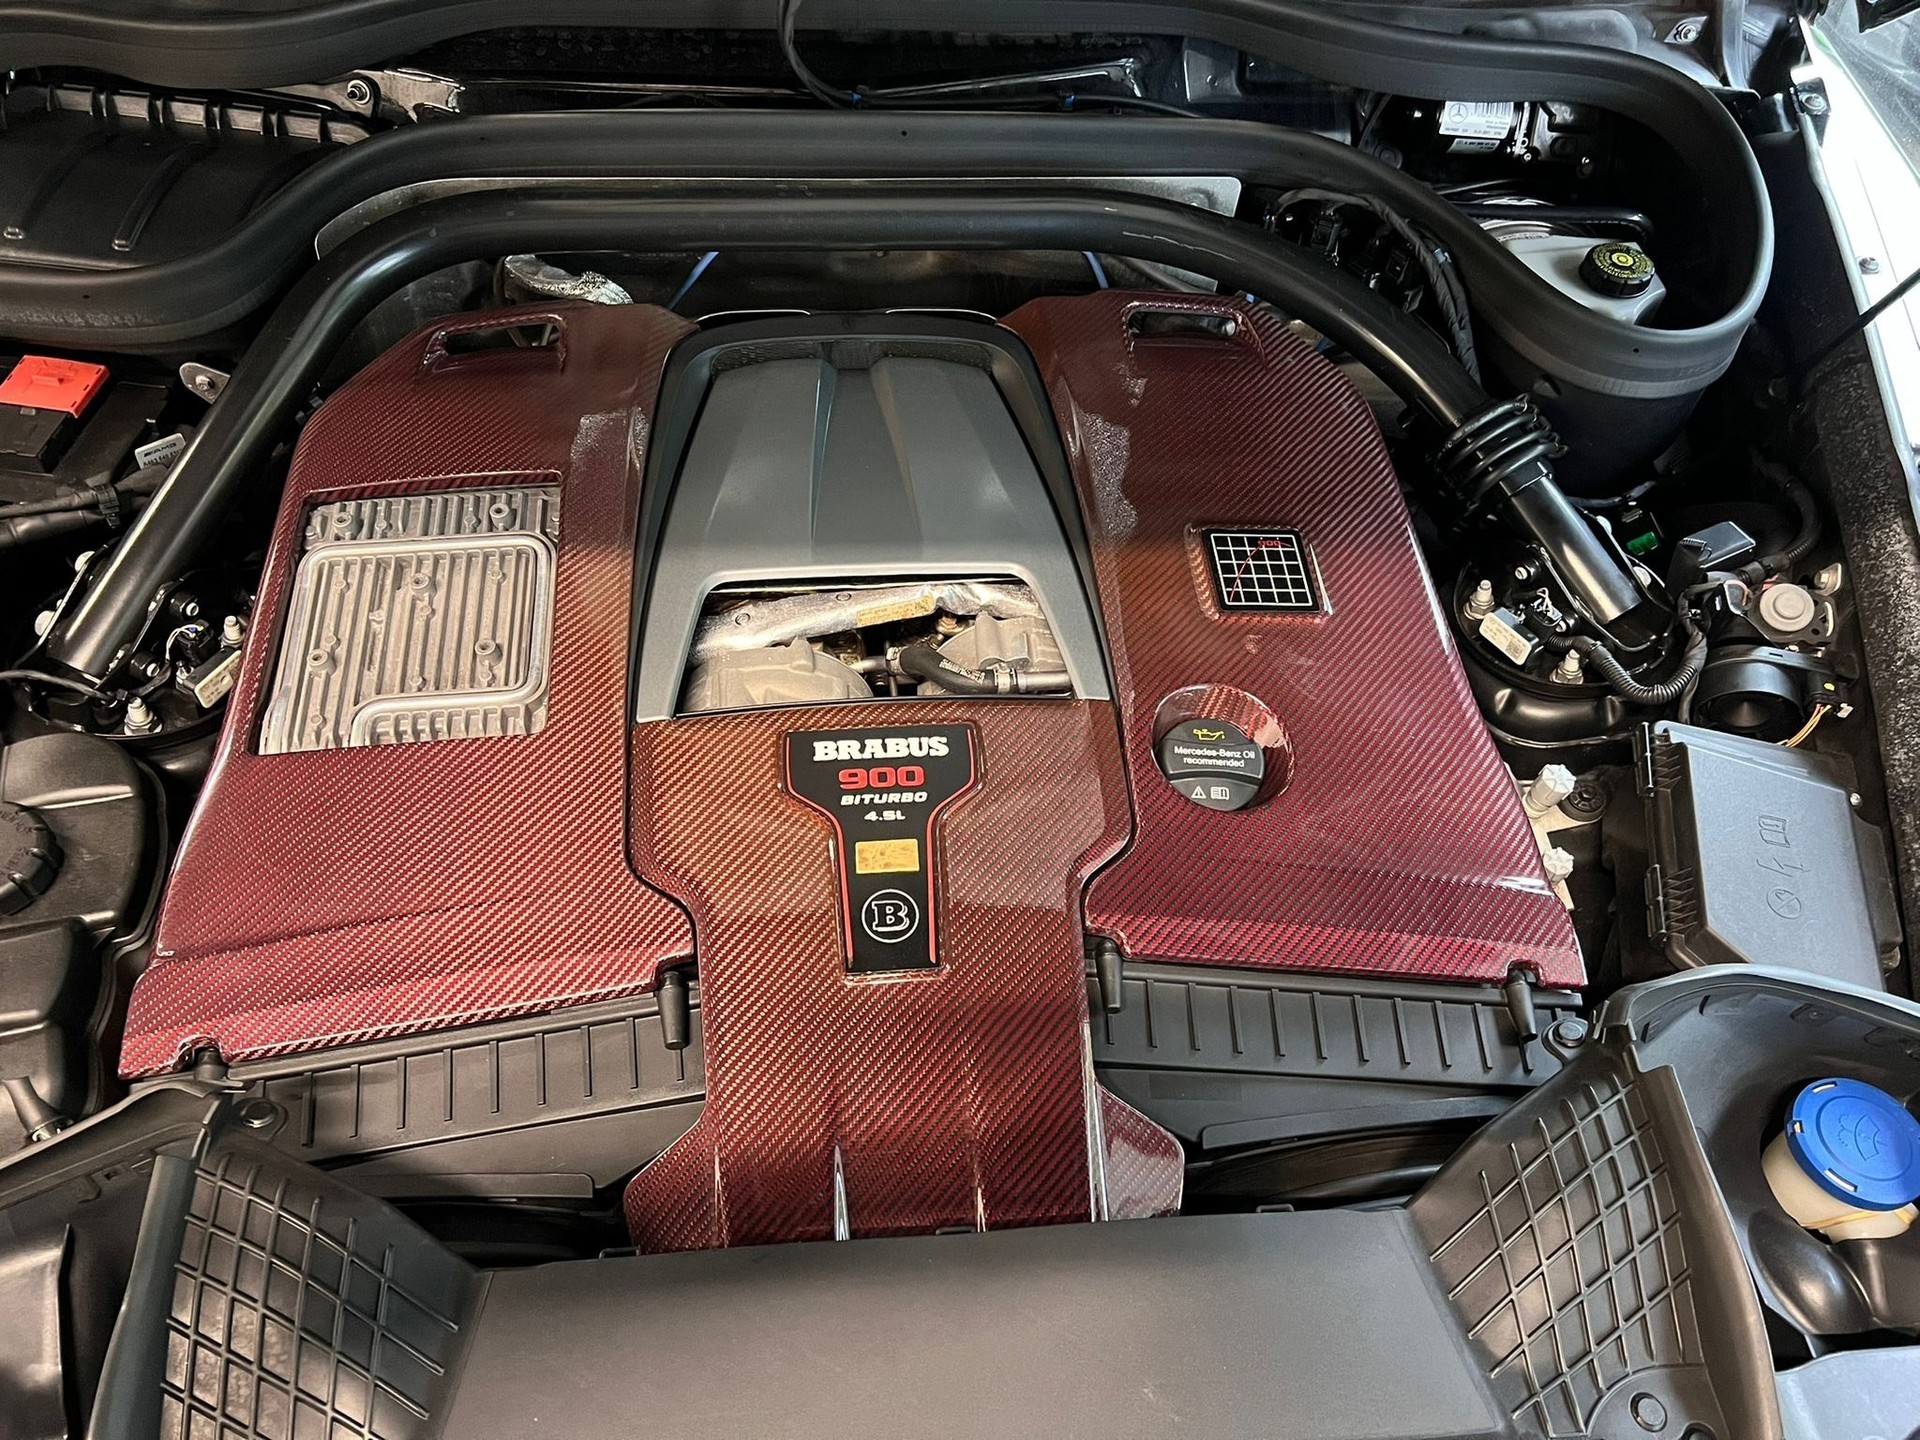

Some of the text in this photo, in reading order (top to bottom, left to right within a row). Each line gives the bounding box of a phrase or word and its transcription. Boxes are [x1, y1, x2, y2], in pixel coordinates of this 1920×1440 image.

[813, 736, 949, 762] BRABUS
[1174, 746, 1255, 759] Mercedes-Benz Oil
[1183, 757, 1244, 767] recommended
[838, 766, 925, 789] 900
[840, 792, 928, 806] BITURBO
[864, 810, 906, 821] 4.5L
[872, 900, 909, 931] B
